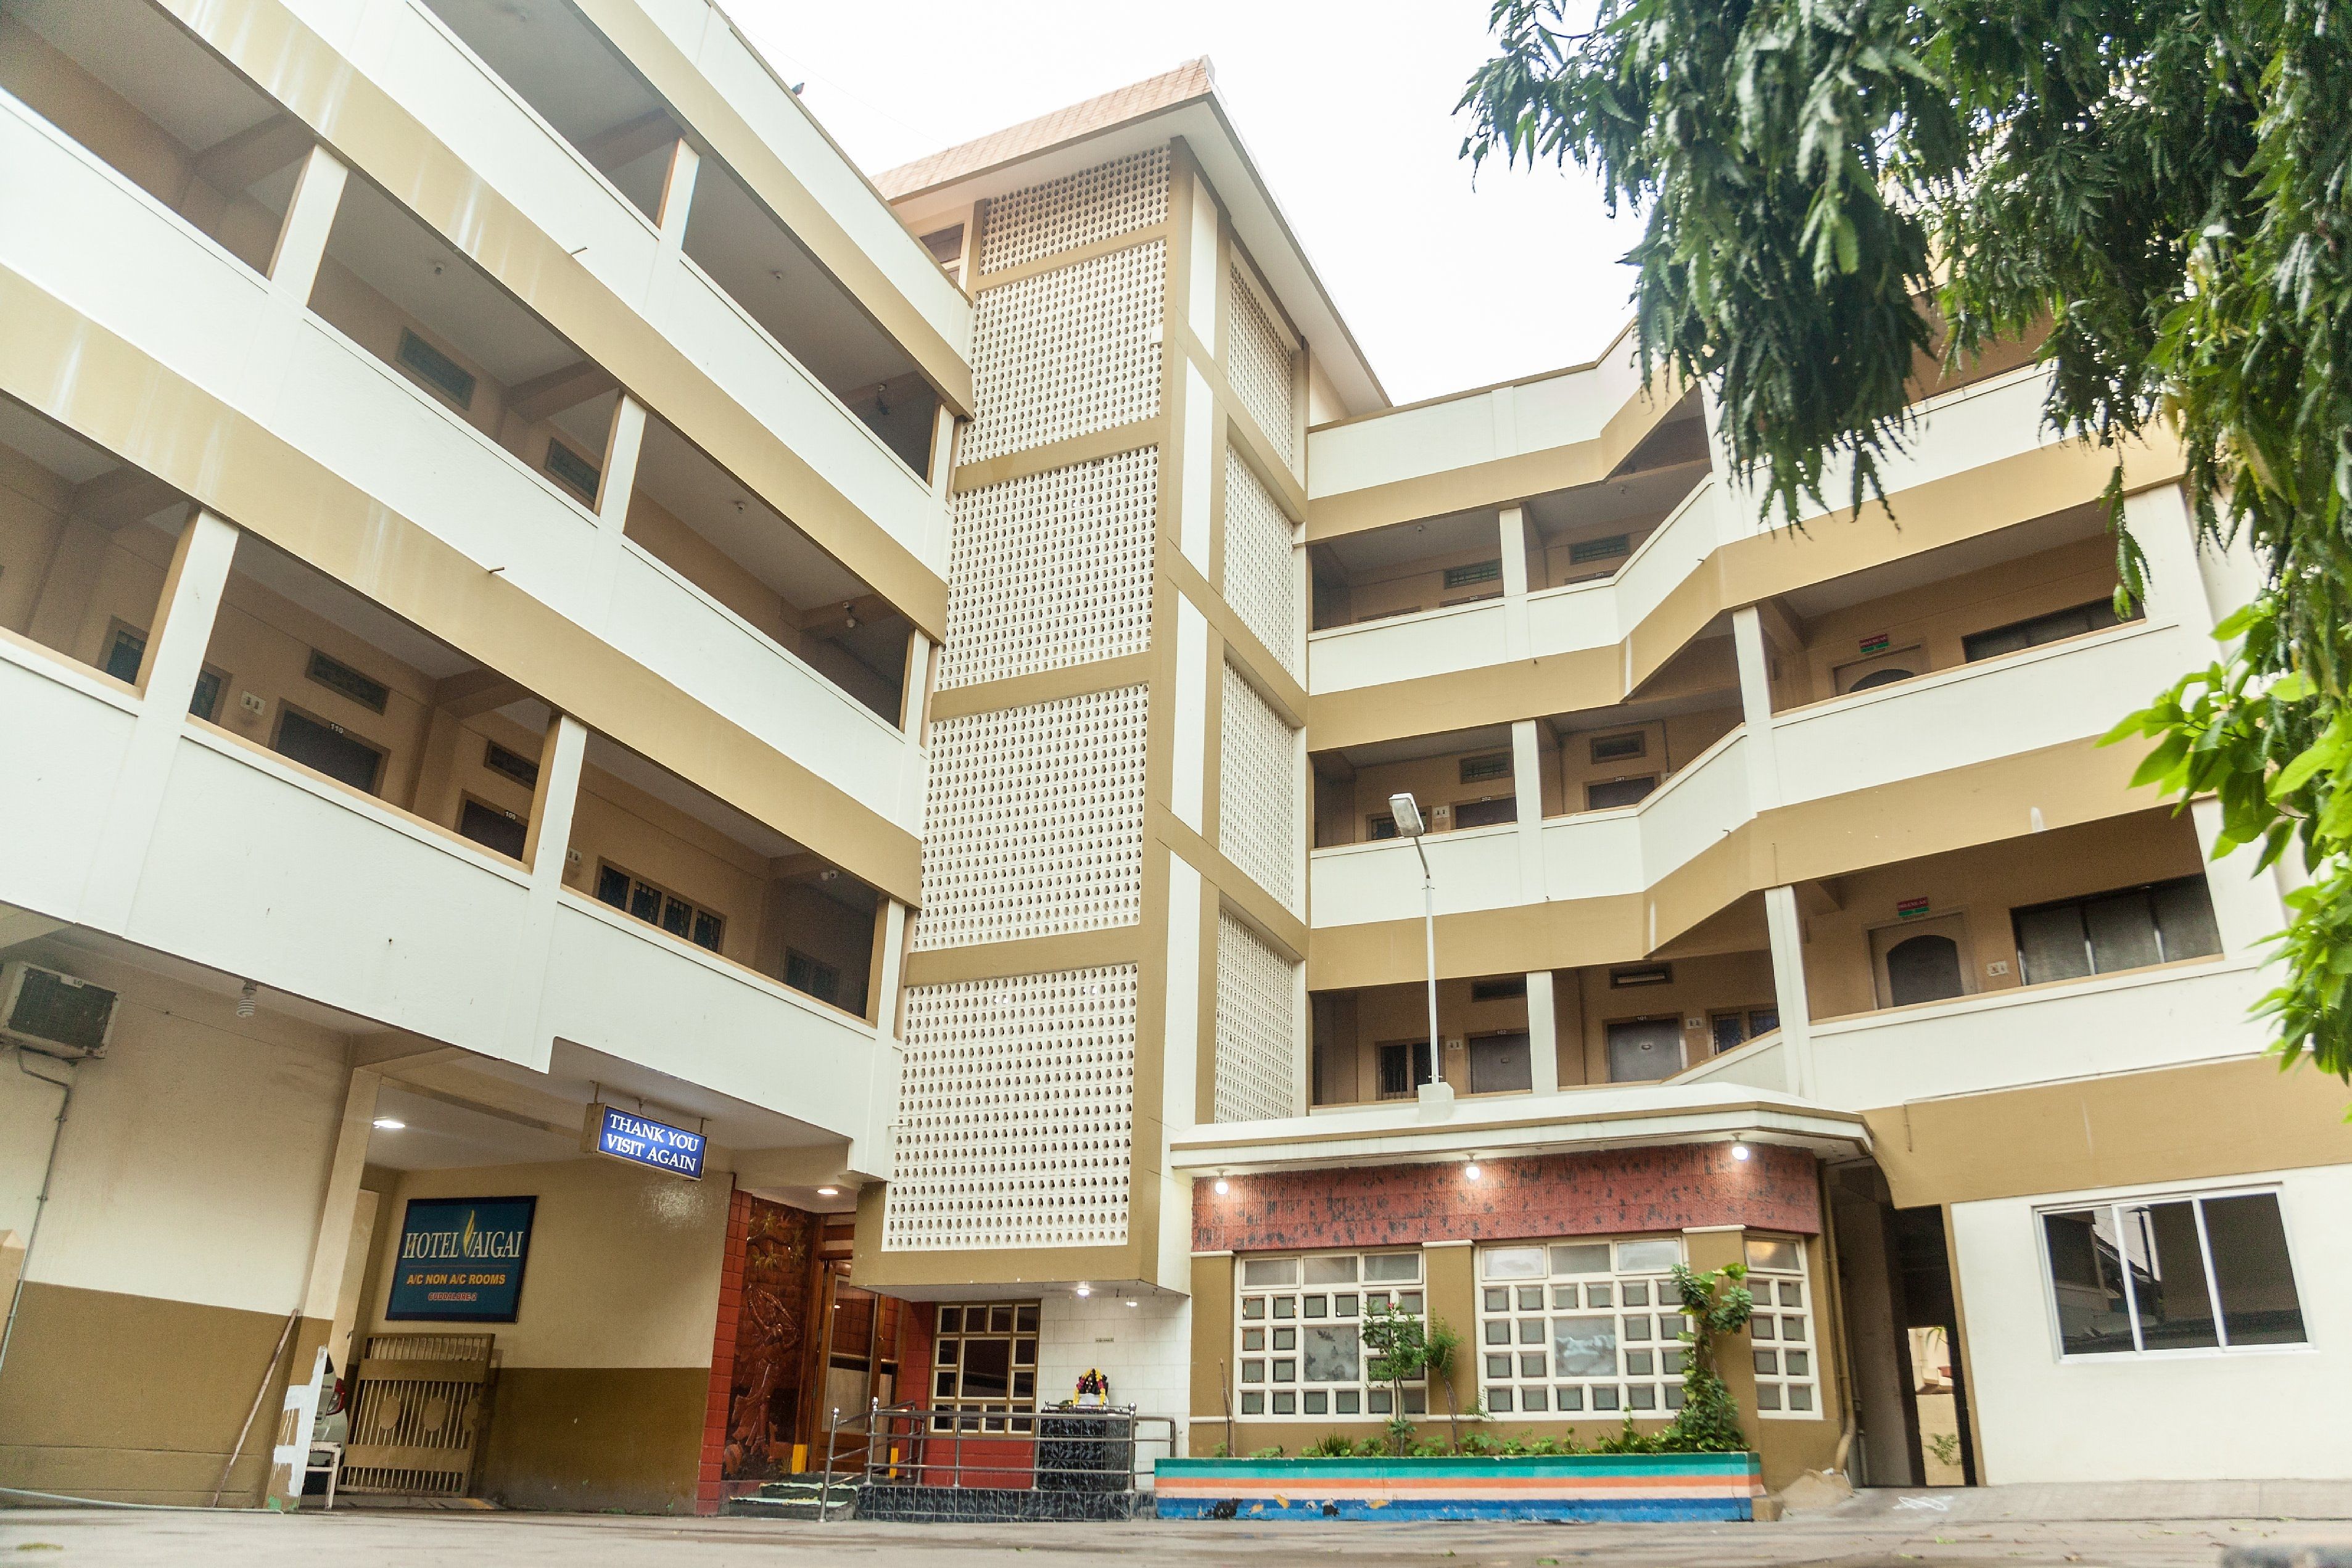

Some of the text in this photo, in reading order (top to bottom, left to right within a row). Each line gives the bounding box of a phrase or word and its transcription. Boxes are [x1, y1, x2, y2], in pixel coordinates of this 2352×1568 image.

[505, 811, 516, 820] 109
[609, 1114, 699, 1152] THANK YOU
[607, 1133, 697, 1171] VISIT AGAIN
[402, 1229, 524, 1259] HOTEL VAIGAI
[406, 1274, 506, 1285] A/C NON A/C ROOMS
